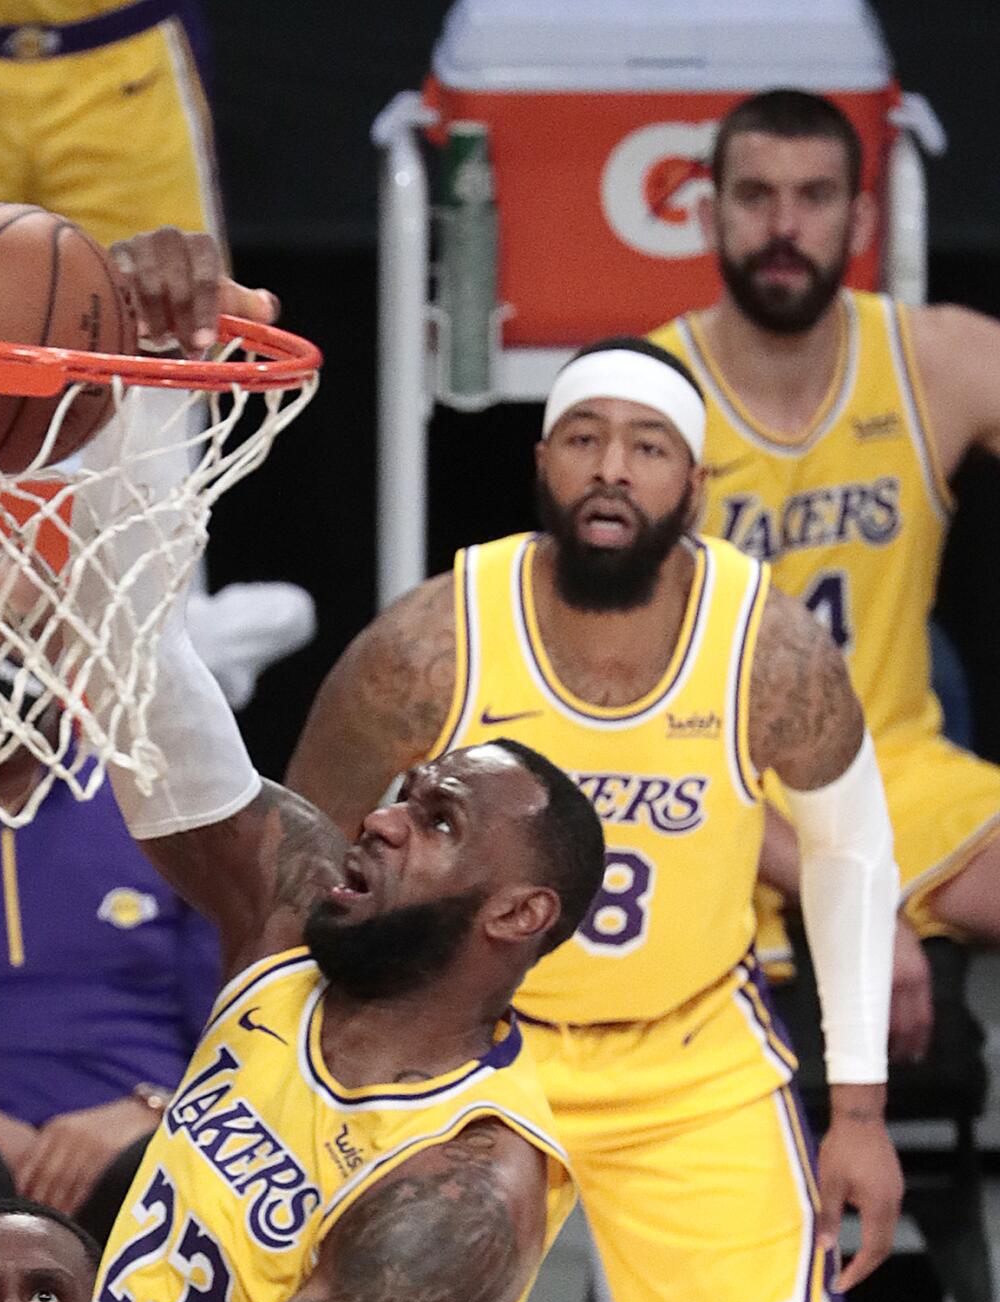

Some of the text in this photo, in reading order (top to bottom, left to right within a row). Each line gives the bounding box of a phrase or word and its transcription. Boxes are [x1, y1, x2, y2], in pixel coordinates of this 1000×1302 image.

[575, 772, 708, 835] ERS
[578, 849, 653, 950] 8
[166, 1044, 323, 1249] LAKERS
[335, 1122, 363, 1171] wis
